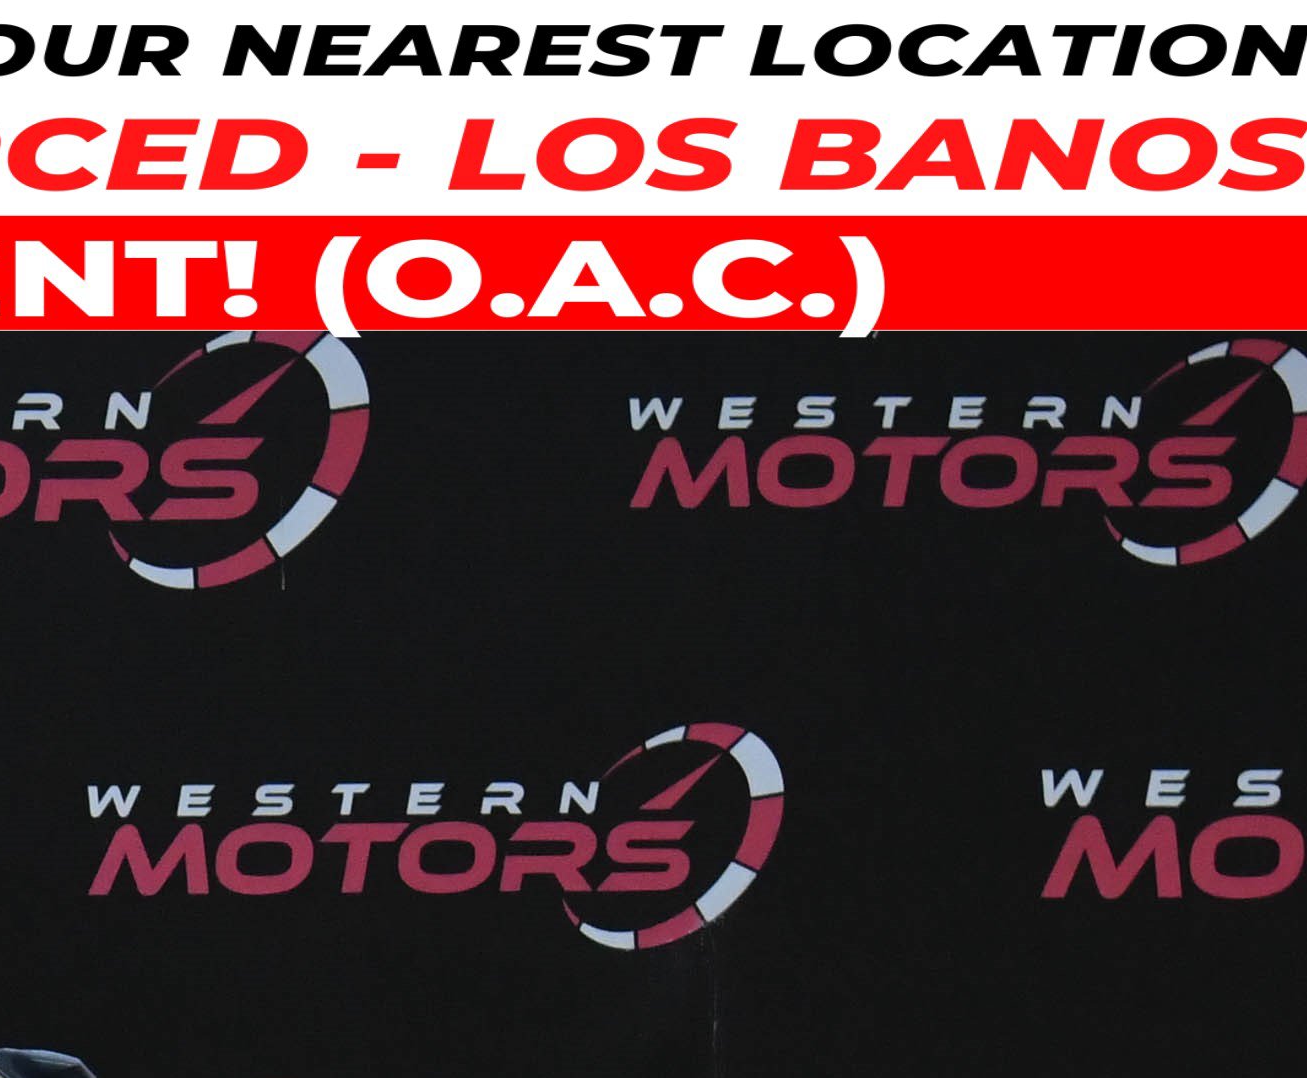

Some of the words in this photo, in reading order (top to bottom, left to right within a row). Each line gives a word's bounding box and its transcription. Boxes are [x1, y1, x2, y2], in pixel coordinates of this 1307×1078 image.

[630, 397, 1141, 430] WESTERN
[632, 435, 1234, 508] MOTORS
[88, 782, 598, 817] WESTERN
[90, 821, 692, 895] MOTORS
